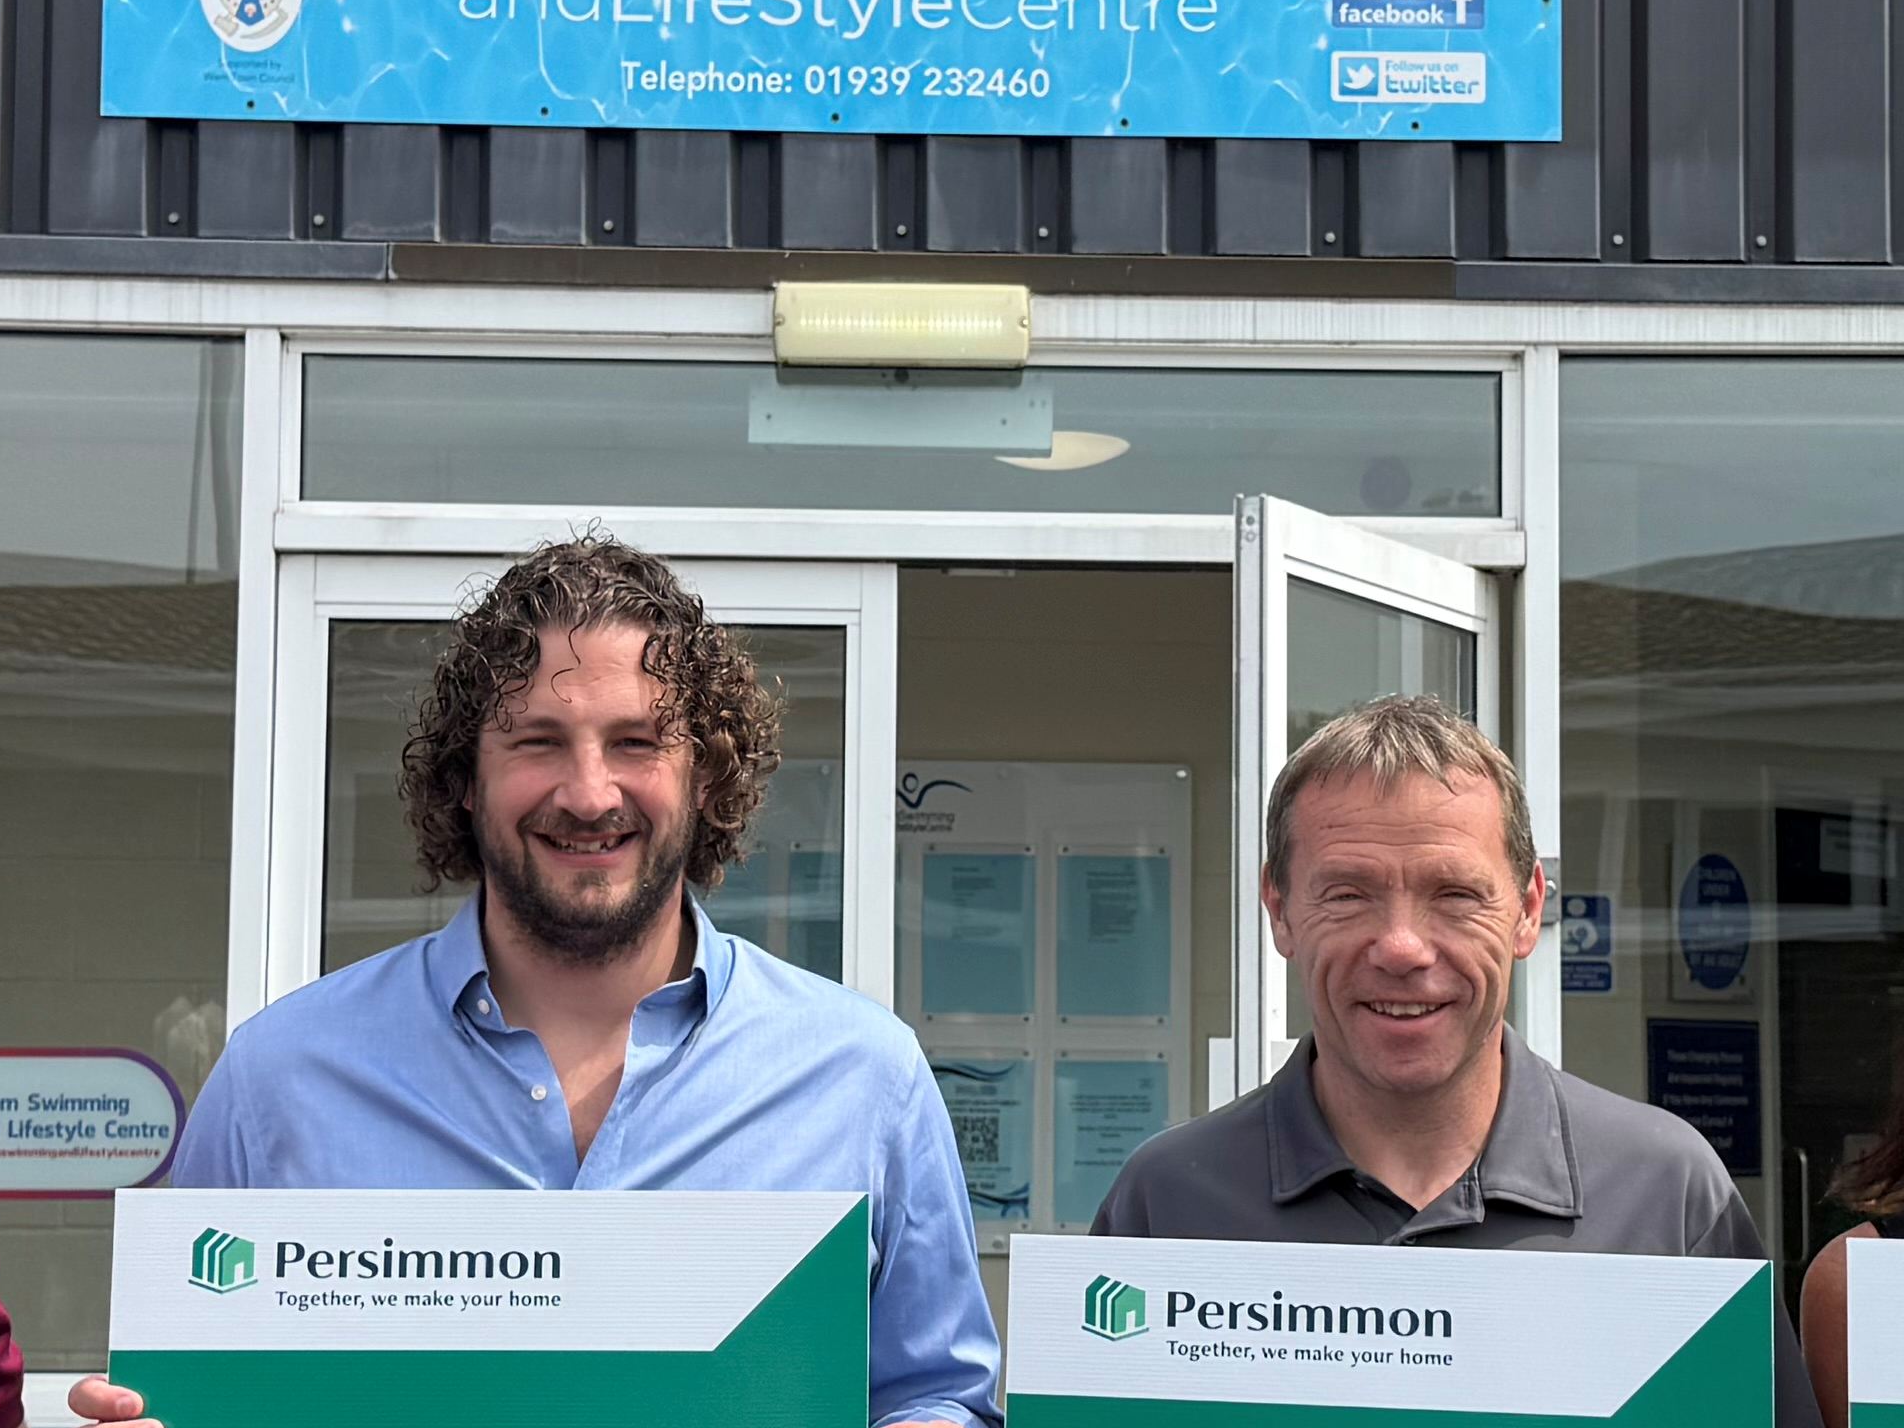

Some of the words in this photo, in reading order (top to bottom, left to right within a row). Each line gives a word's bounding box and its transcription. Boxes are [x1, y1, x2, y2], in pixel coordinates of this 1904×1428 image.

[1339, 3, 1444, 24] facebook
[1385, 60, 1424, 72] Follow
[1429, 63, 1441, 72] us
[1444, 63, 1459, 72] on
[622, 61, 793, 99] Telephone:
[804, 65, 911, 96] 01939
[922, 69, 1050, 98] 232460
[1385, 75, 1480, 94] twitter
[28, 1093, 130, 1116] Swimming
[8, 1119, 96, 1144] Lifestyle
[104, 1119, 170, 1139] Centre
[276, 1238, 561, 1279] Persimmon
[276, 1291, 365, 1312] Together,
[371, 1295, 398, 1307] we
[404, 1290, 454, 1307] make
[460, 1295, 502, 1312] your
[509, 1290, 561, 1307] home
[1167, 1291, 1452, 1337] Persimmon
[1166, 1340, 1256, 1362] Together,
[1261, 1347, 1288, 1360] we
[1294, 1345, 1345, 1362] make
[1351, 1351, 1394, 1368] your
[1400, 1347, 1453, 1366] home
